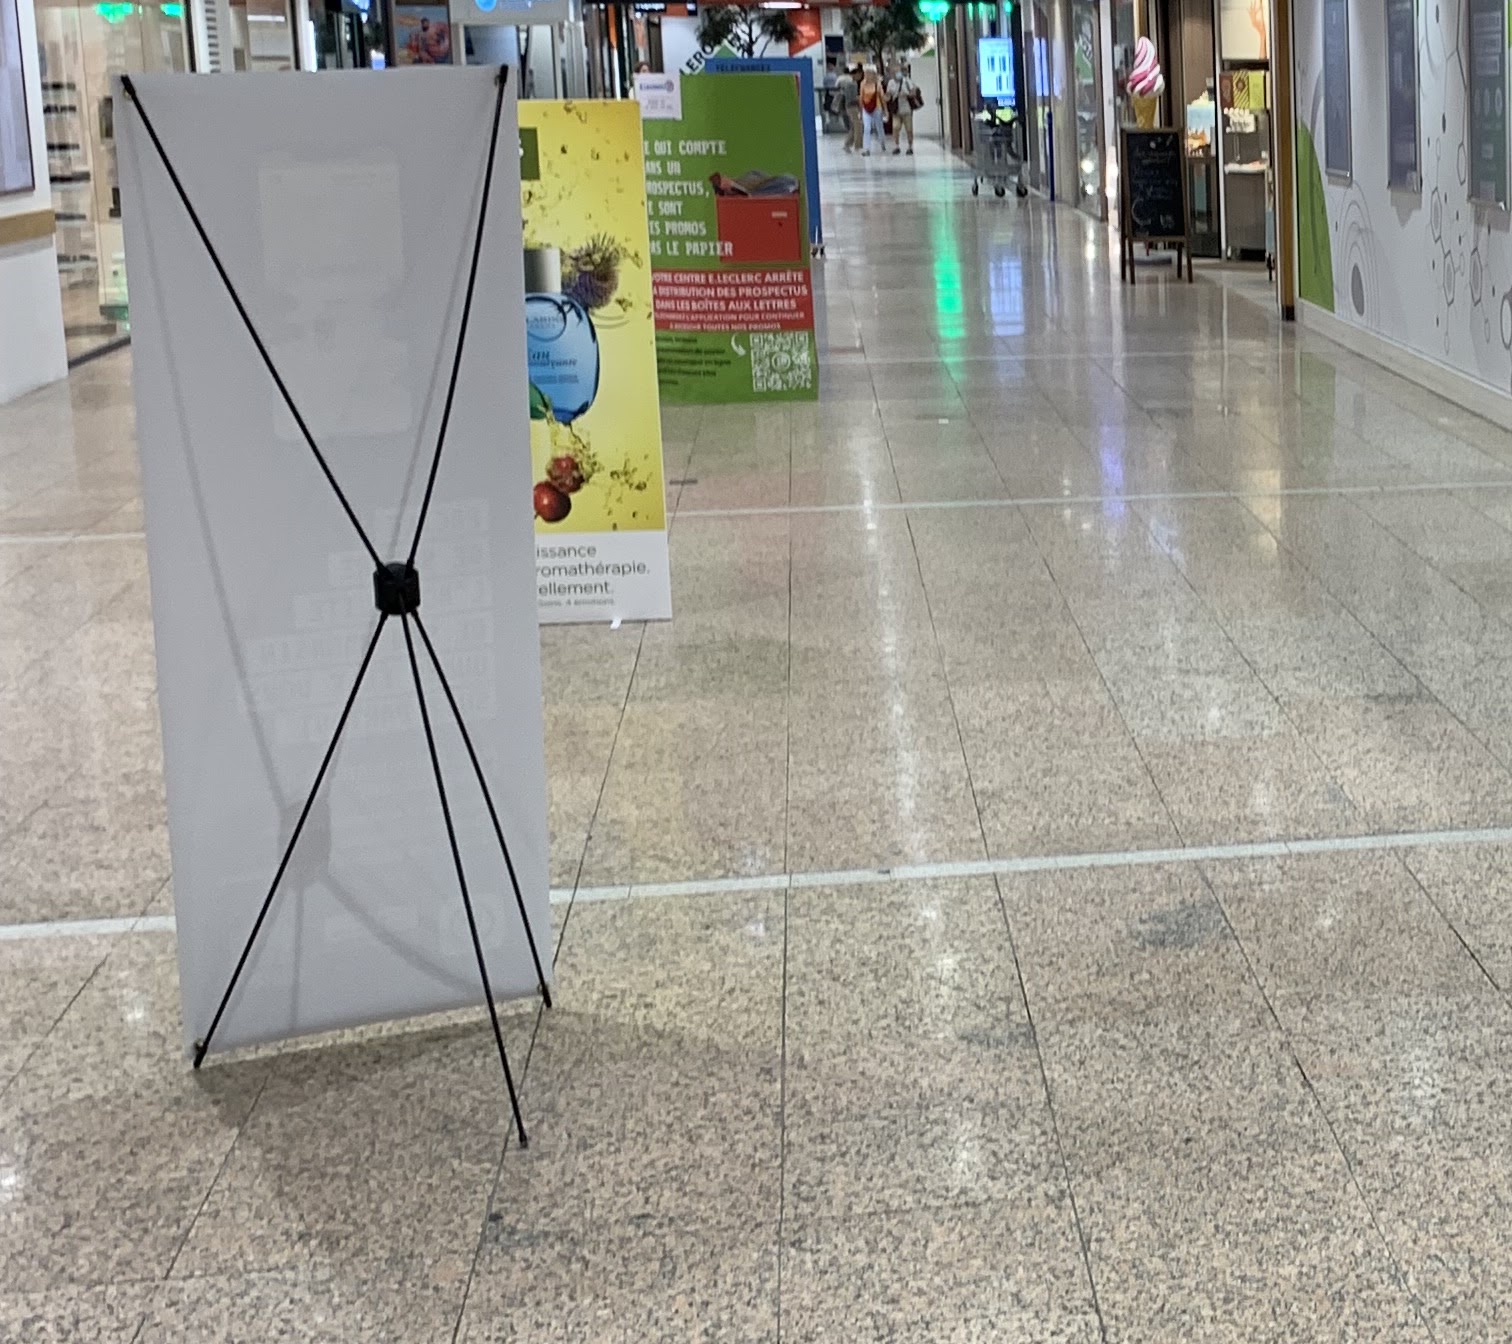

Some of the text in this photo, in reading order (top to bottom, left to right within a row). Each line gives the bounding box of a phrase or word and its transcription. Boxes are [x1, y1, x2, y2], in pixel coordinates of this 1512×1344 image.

[654, 139, 672, 156] QUI
[678, 139, 727, 156] COMPTE
[658, 200, 683, 216] SONT
[664, 220, 707, 236] PROMOS
[666, 240, 680, 256] LE
[685, 240, 734, 257] PAPIER
[673, 272, 706, 284] CENTRE
[708, 272, 762, 285] E.LECLERC
[764, 269, 805, 283] ARRÊTE
[658, 286, 715, 297] DISTRIBUTION
[716, 285, 737, 297] DES
[738, 284, 809, 297] PROSPECTUS
[676, 299, 691, 311] LES
[691, 297, 726, 311] BOÎTES
[727, 299, 751, 311] AUX
[753, 298, 797, 311] LETTRES
